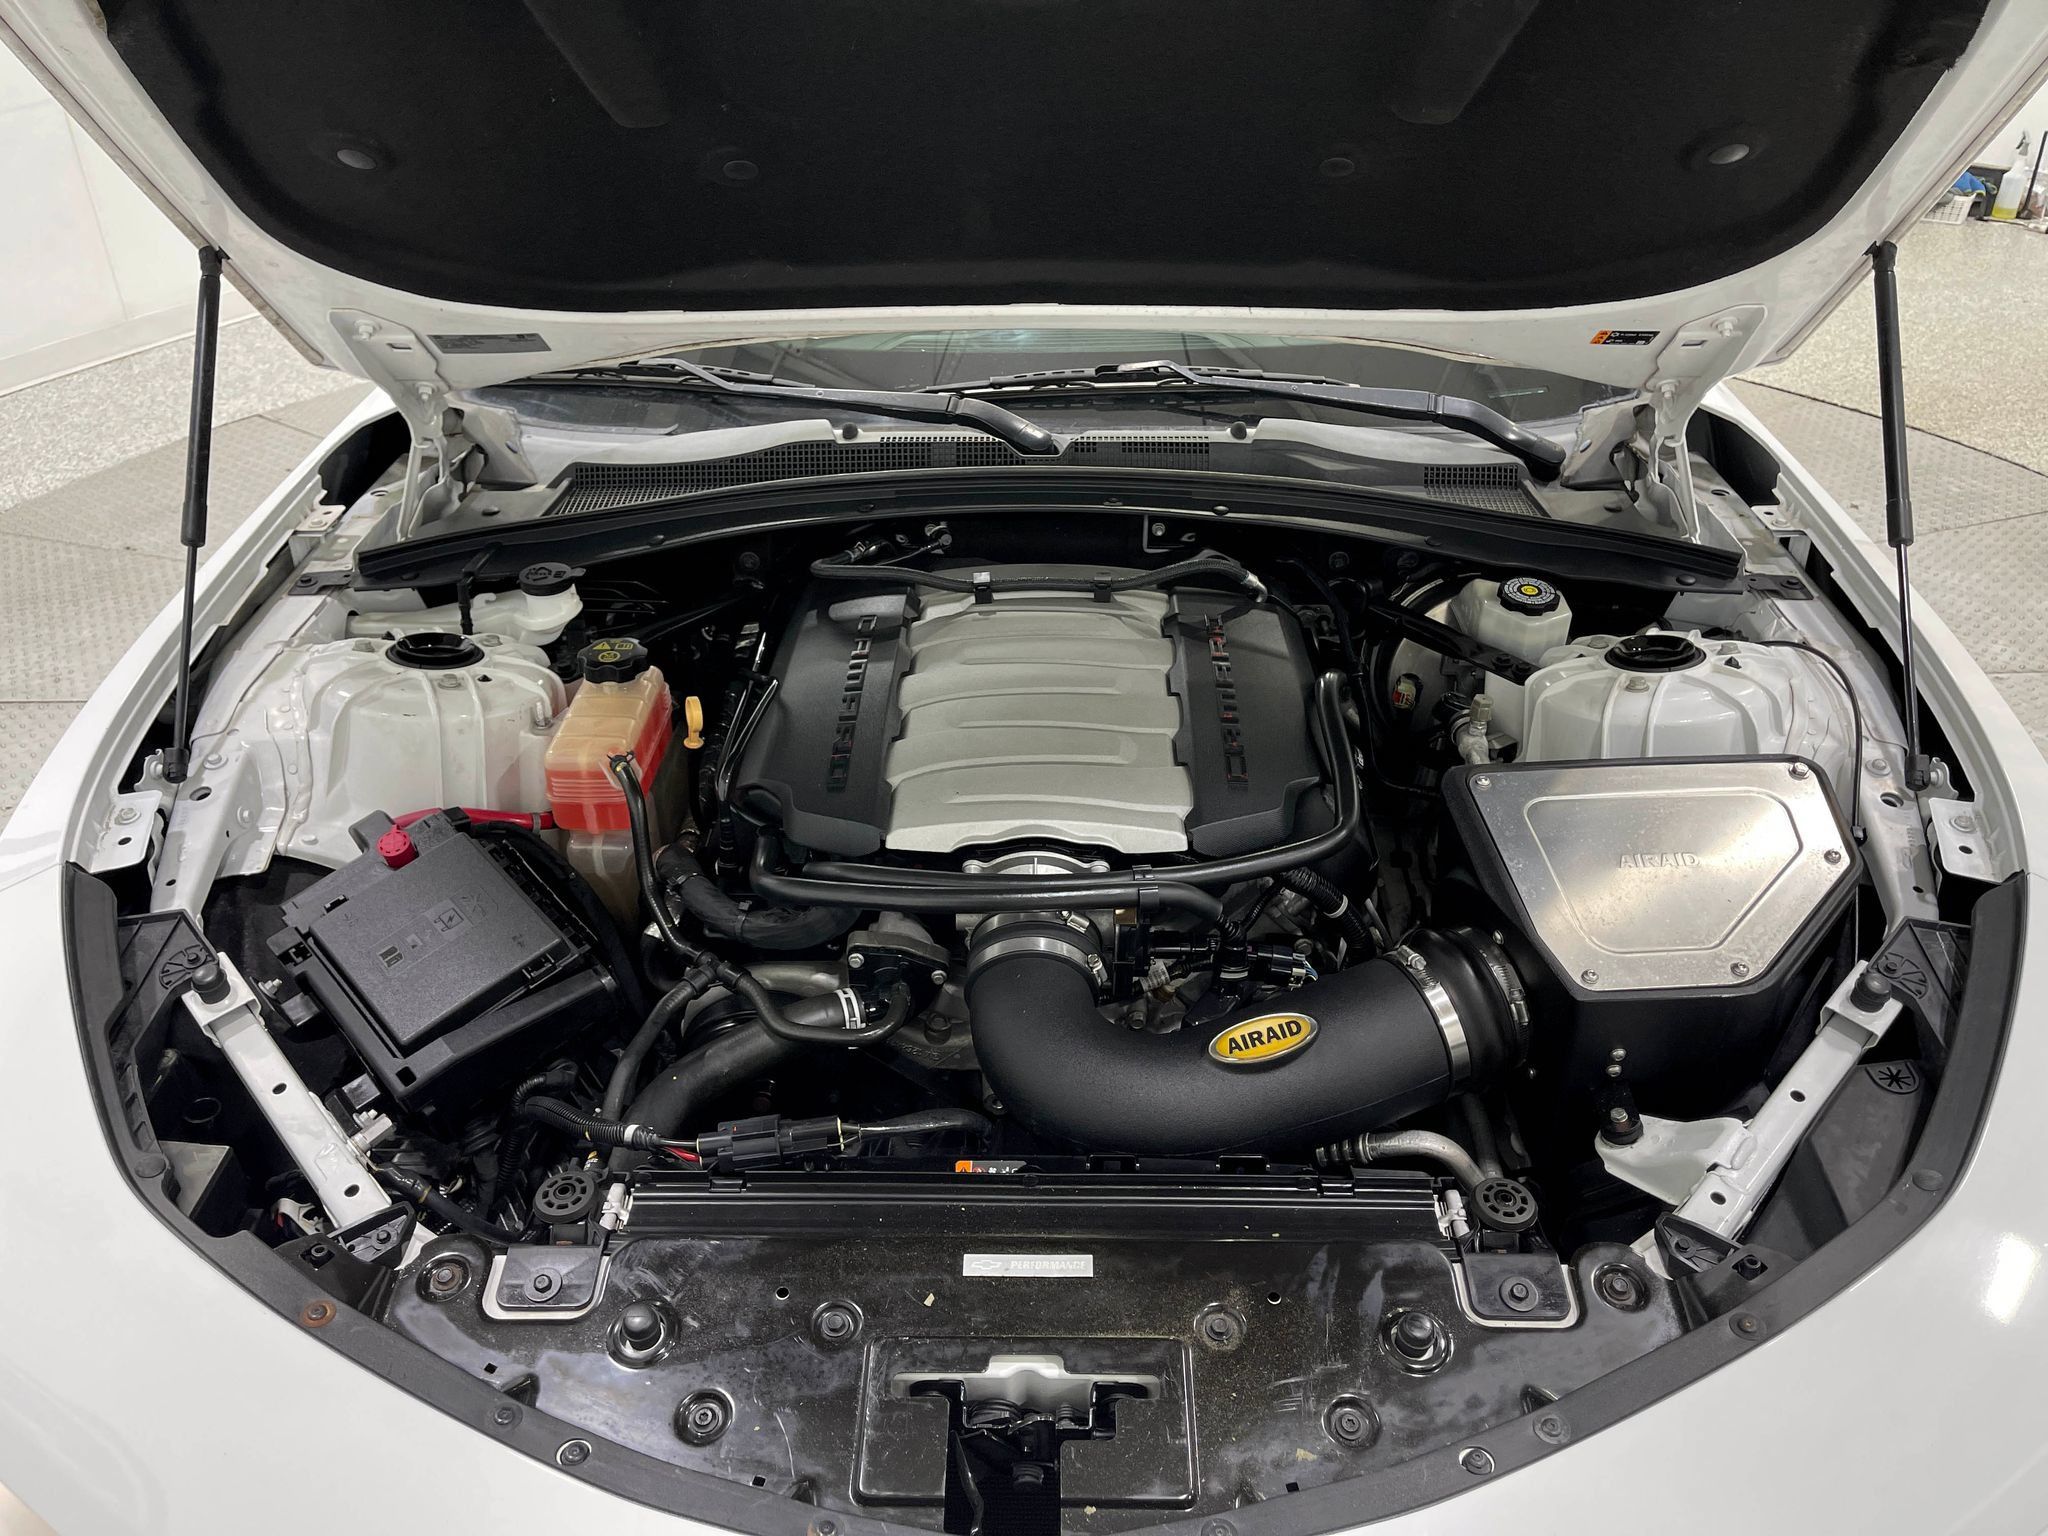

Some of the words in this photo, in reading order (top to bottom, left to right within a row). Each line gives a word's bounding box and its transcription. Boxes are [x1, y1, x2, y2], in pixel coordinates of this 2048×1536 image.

[1619, 852, 1701, 869] AIRAID
[1228, 1020, 1302, 1054] AIRAID
[1010, 1260, 1086, 1270] PERFORMANCE
